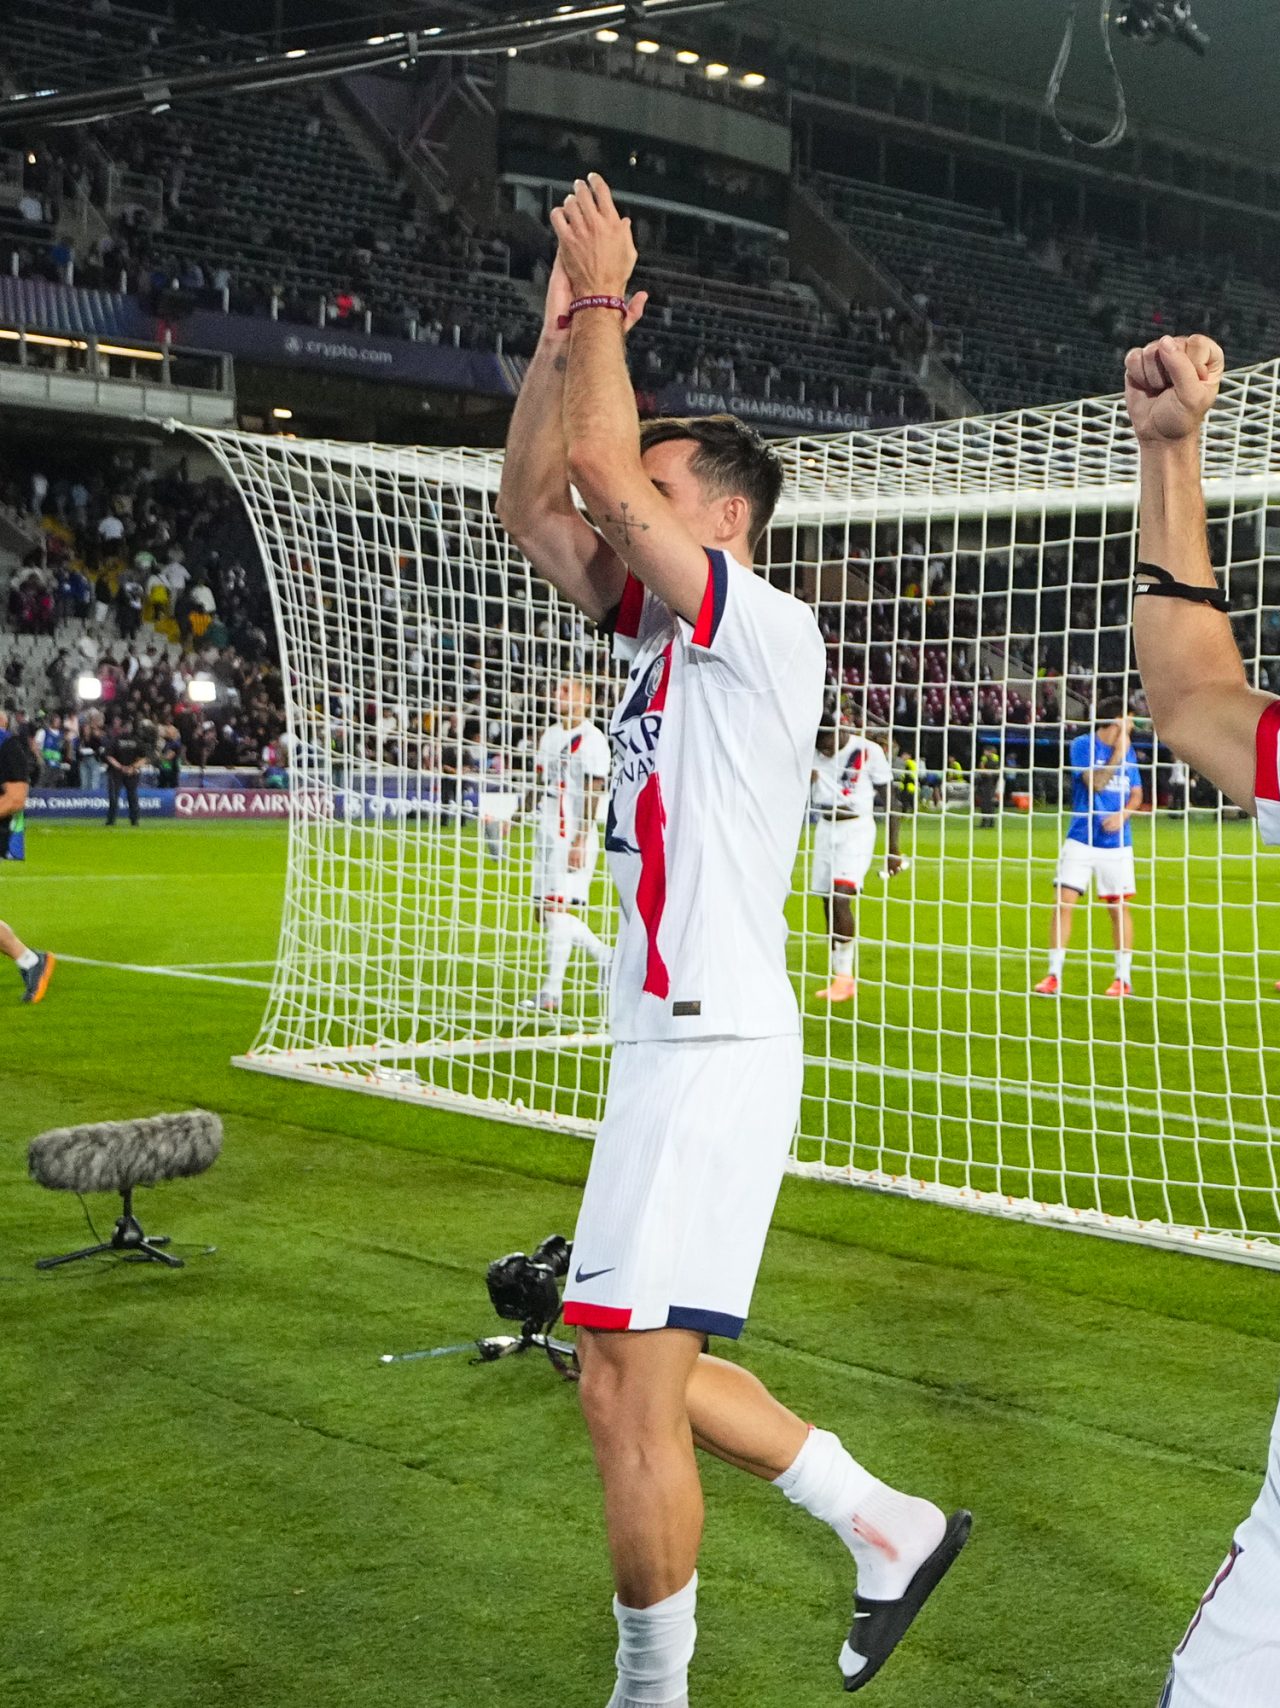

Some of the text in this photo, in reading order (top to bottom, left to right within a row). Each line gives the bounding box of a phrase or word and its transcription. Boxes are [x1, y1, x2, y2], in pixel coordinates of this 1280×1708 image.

[305, 341, 393, 363] crypto.com
[685, 392, 870, 430] UEFA CHAMPIONS LEAGUE
[25, 797, 161, 809] EFA CHAMPION LGUE
[175, 793, 246, 815] QATAR
